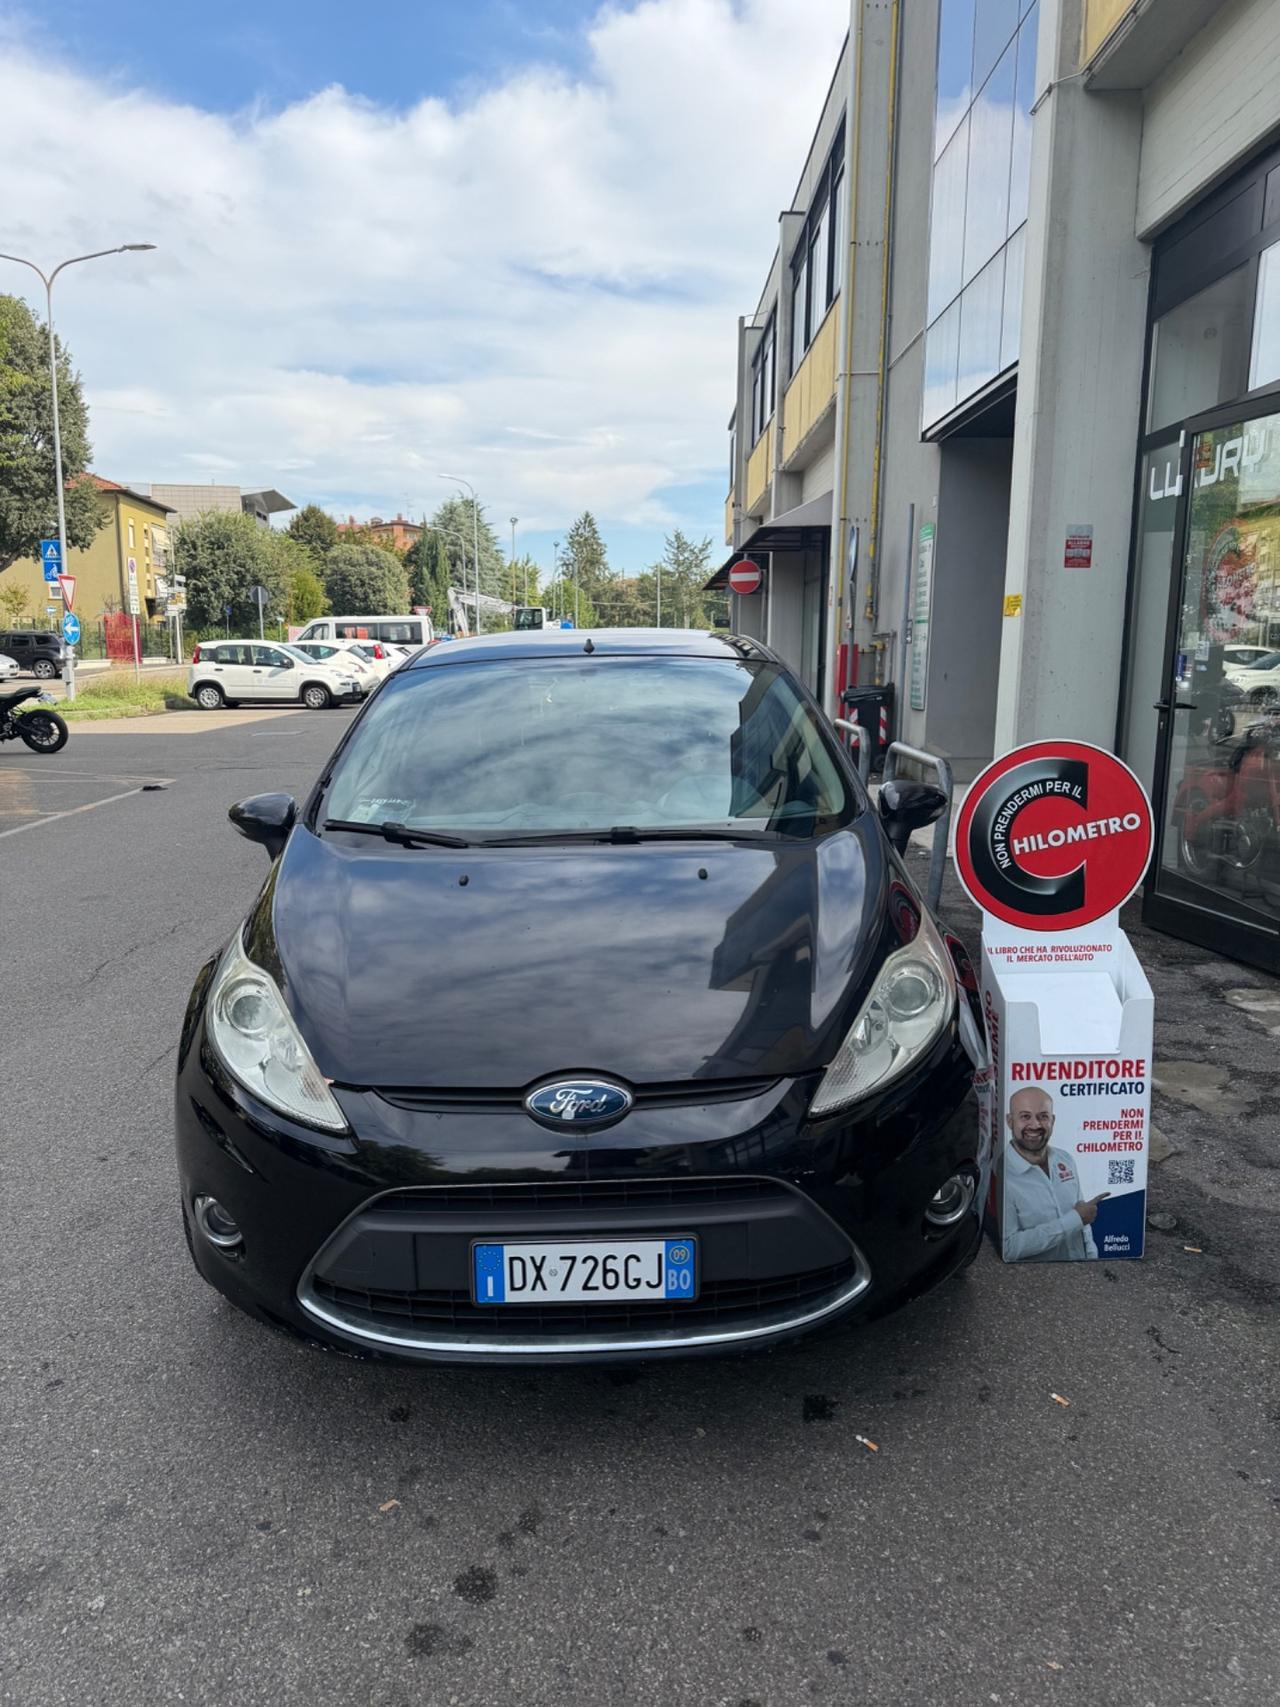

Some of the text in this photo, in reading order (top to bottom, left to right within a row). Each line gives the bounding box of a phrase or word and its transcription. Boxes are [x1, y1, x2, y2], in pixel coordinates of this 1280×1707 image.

[1150, 429, 1266, 500] LUURY
[994, 780, 1082, 869] NON PRENDERMI PER IL
[1012, 813, 1141, 855] HILOMETRO
[995, 946, 1018, 954] LIBRO
[1019, 945, 1034, 954] CHE
[1036, 945, 1047, 953] HA
[1051, 944, 1113, 953] RIVOLUZIONATO
[1016, 954, 1053, 963] MERCATO
[1055, 953, 1094, 962] DELL'AUTO
[1011, 1059, 1146, 1081] RIVENDITORE
[1060, 1081, 1145, 1097] CERTIFICATO
[550, 1088, 607, 1113] Ford
[1120, 1108, 1144, 1119] NON
[1082, 1120, 1144, 1131] PRENDERMI
[1112, 1130, 1144, 1141] PER IL
[1076, 1141, 1143, 1153] CHILOMETRO
[1103, 1234, 1129, 1243] Alfredo
[673, 1249, 686, 1261] 09
[667, 1268, 692, 1291] BO
